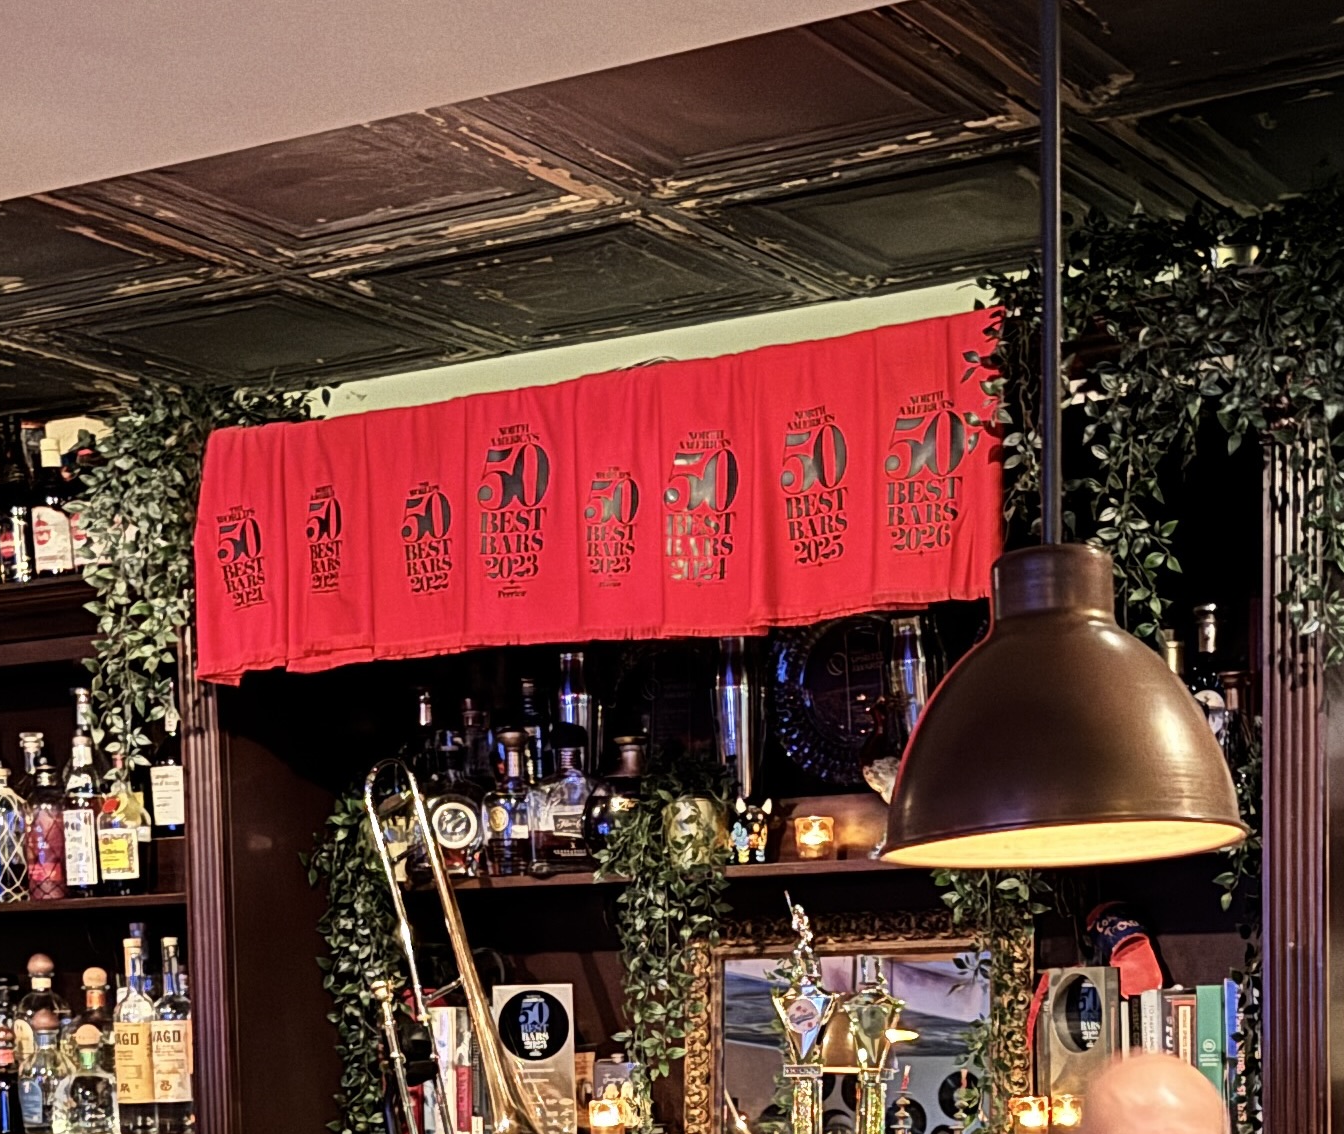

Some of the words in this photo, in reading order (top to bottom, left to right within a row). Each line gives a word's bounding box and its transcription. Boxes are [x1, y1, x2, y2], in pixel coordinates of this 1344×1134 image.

[885, 410, 966, 480] 50
[781, 424, 848, 495] 50
[477, 443, 551, 511] 50
[664, 448, 739, 512] 50
[584, 478, 639, 525] 50
[887, 476, 963, 505] BEST
[785, 487, 848, 520] BEST
[888, 502, 959, 526] BARS
[306, 498, 341, 542] 50
[401, 491, 451, 543] 50
[480, 507, 547, 534] BEST
[667, 511, 736, 536] BEST
[788, 513, 848, 541] BARS
[218, 518, 261, 563] 50
[479, 533, 544, 555] BARS
[586, 523, 637, 542] BEST
[891, 524, 951, 551] 2026
[310, 540, 342, 559] BEST
[404, 539, 452, 561] BEST
[586, 540, 636, 558] BARS
[665, 536, 733, 556] BARS
[794, 534, 844, 565] 2025
[222, 557, 264, 580] BEST
[311, 557, 341, 575] BARS
[407, 556, 452, 577] BARS
[485, 554, 539, 579] 2023
[589, 556, 632, 575] 2023
[671, 557, 728, 580] 2024
[225, 573, 265, 594] BARS
[410, 573, 448, 593] 2022
[518, 1002, 550, 1025] 50
[521, 1024, 549, 1033] BEST
